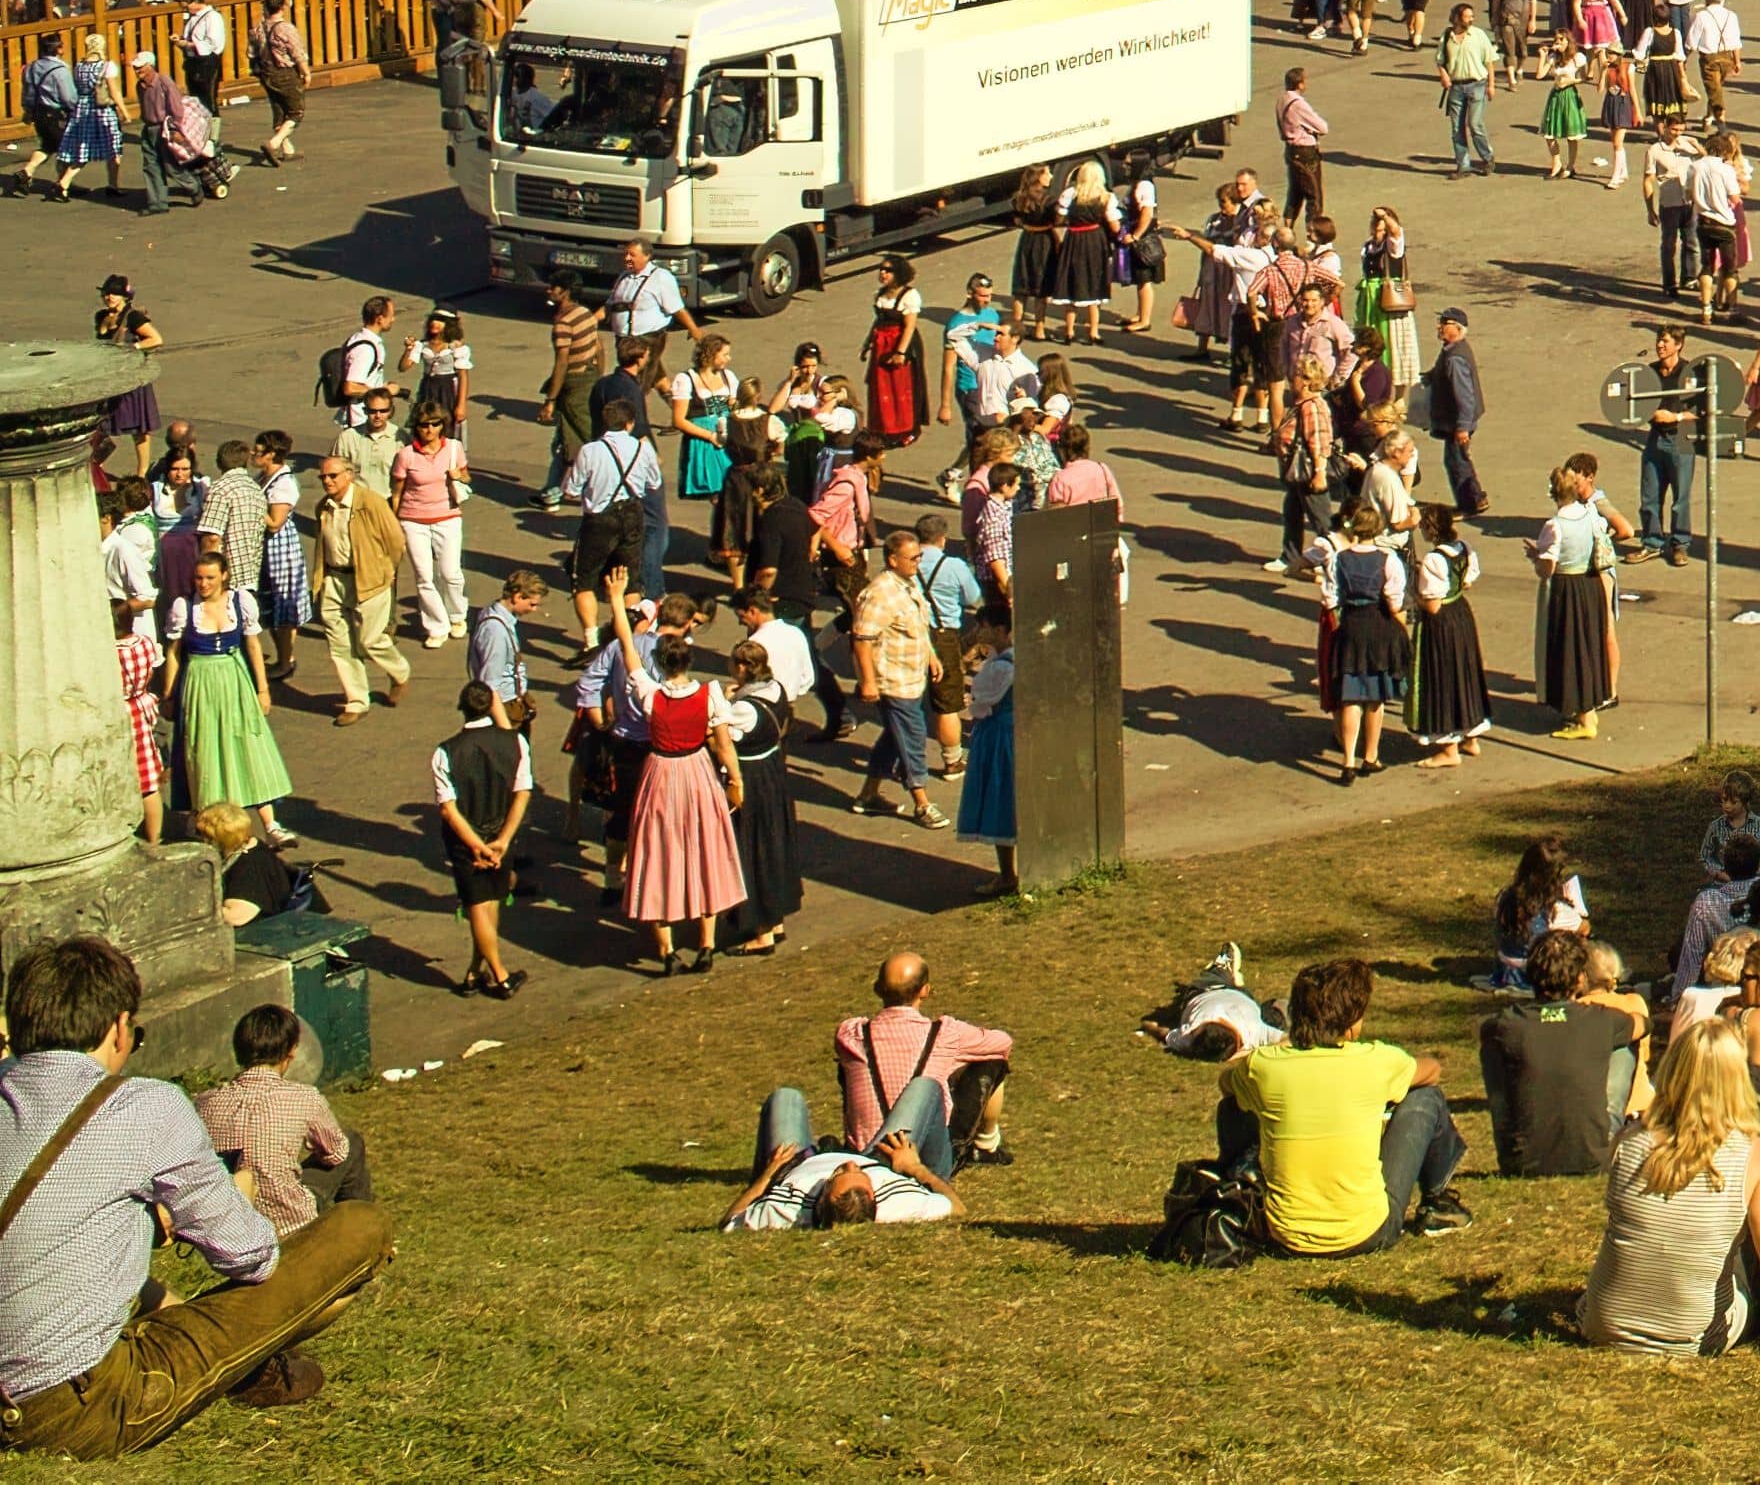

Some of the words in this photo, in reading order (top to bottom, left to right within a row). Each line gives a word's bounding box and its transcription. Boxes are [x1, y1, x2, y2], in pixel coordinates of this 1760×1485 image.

[977, 59, 1050, 89] Visionen
[1056, 47, 1113, 73] werden
[1118, 22, 1211, 58] Wirklichkeit!
[552, 187, 600, 204] MAN
